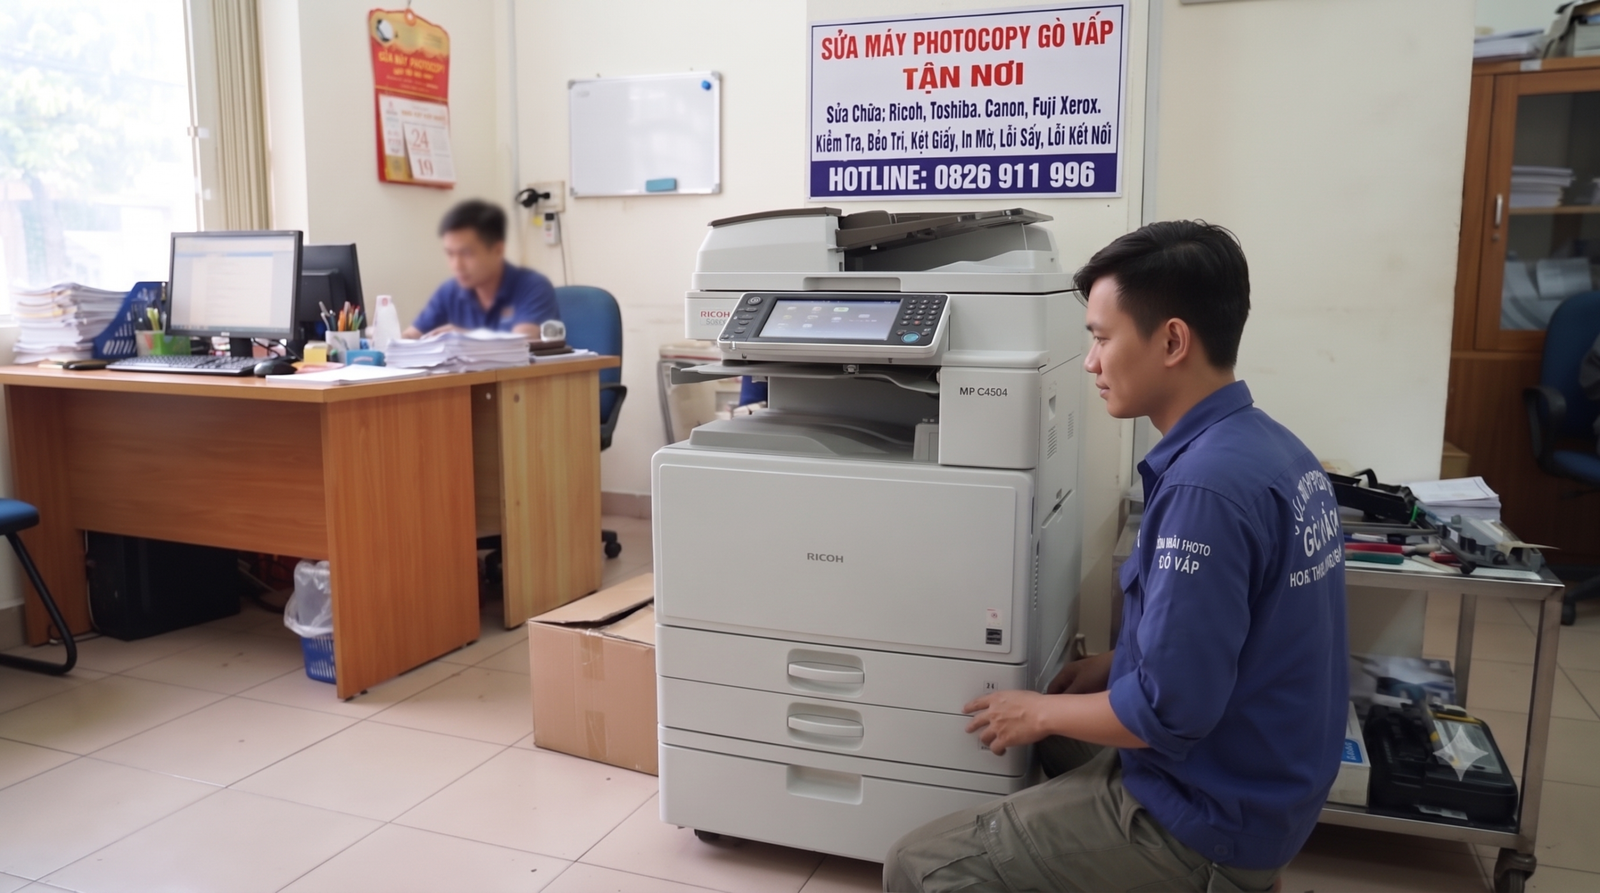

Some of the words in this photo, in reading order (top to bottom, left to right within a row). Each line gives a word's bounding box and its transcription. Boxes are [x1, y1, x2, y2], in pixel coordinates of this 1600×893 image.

[821, 29, 859, 60] SỬA
[865, 28, 907, 58] MÁY
[913, 25, 1031, 55] PHOTOCOPY
[1038, 17, 1066, 48] GÒ
[1072, 11, 1114, 46] VẤP
[903, 61, 960, 94] TẬN
[971, 60, 1024, 87] NƠI
[826, 102, 849, 124] Sửa
[889, 101, 926, 123] Ricoh,
[930, 100, 981, 120] Toshiba.
[985, 98, 1028, 119] Canon,
[1033, 96, 1056, 119] Fuji
[1060, 95, 1101, 115] Xerox.
[845, 133, 864, 154] Tra,
[932, 126, 958, 153] Giấy,
[962, 129, 972, 149] In
[975, 128, 996, 150] Mờ,
[1000, 124, 1017, 148] Lỗi
[1020, 123, 1044, 150] Sấy,
[1048, 123, 1065, 146] Lỗi
[1069, 122, 1088, 146] Kết
[1091, 121, 1112, 145] Nối
[828, 165, 927, 192] HOTLINE:
[934, 163, 992, 190] 0826
[998, 162, 1039, 189] 911
[1049, 161, 1095, 188] 996
[700, 310, 731, 318] RICOH
[959, 386, 976, 396] MP
[976, 387, 1008, 397] C4504
[806, 552, 844, 563] RICOH
